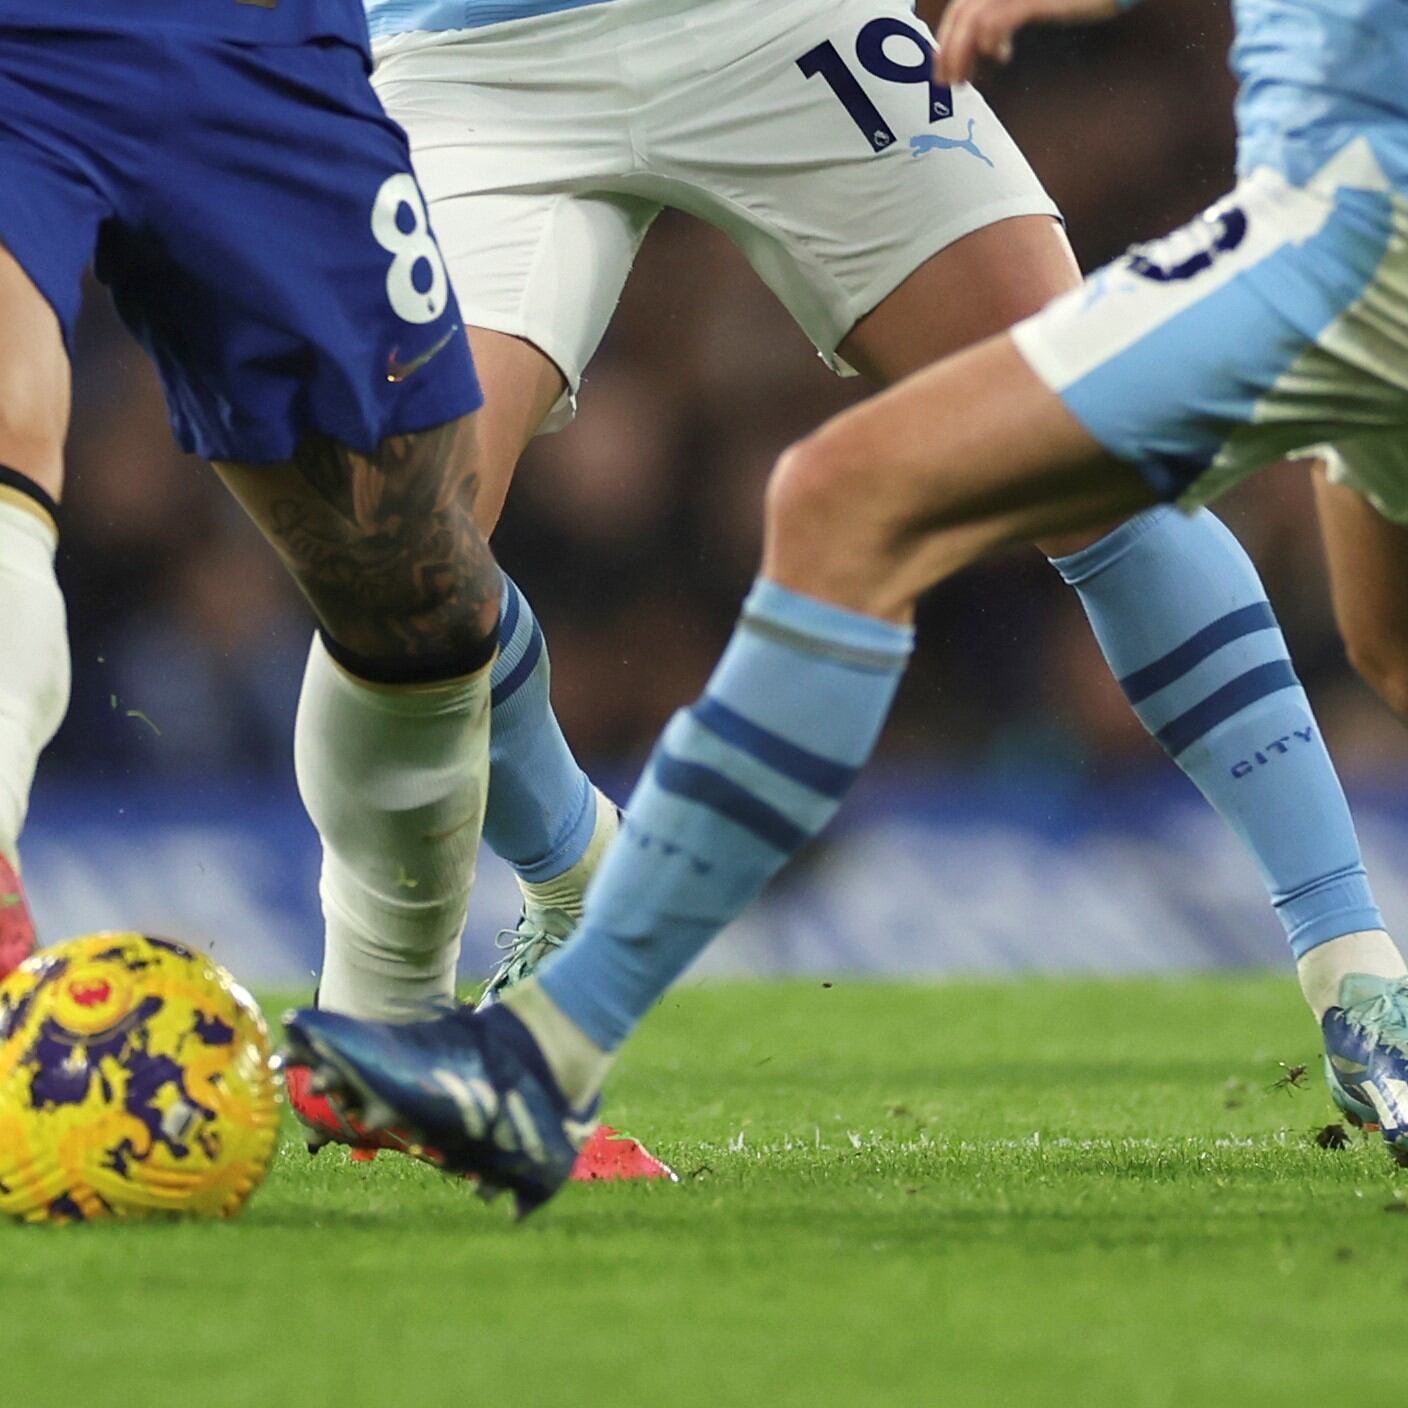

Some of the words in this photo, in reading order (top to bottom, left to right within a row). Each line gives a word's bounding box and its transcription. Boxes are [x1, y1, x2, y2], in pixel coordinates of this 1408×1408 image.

[795, 17, 953, 153] 19
[371, 173, 448, 324] 8
[1231, 726, 1313, 779] CITY
